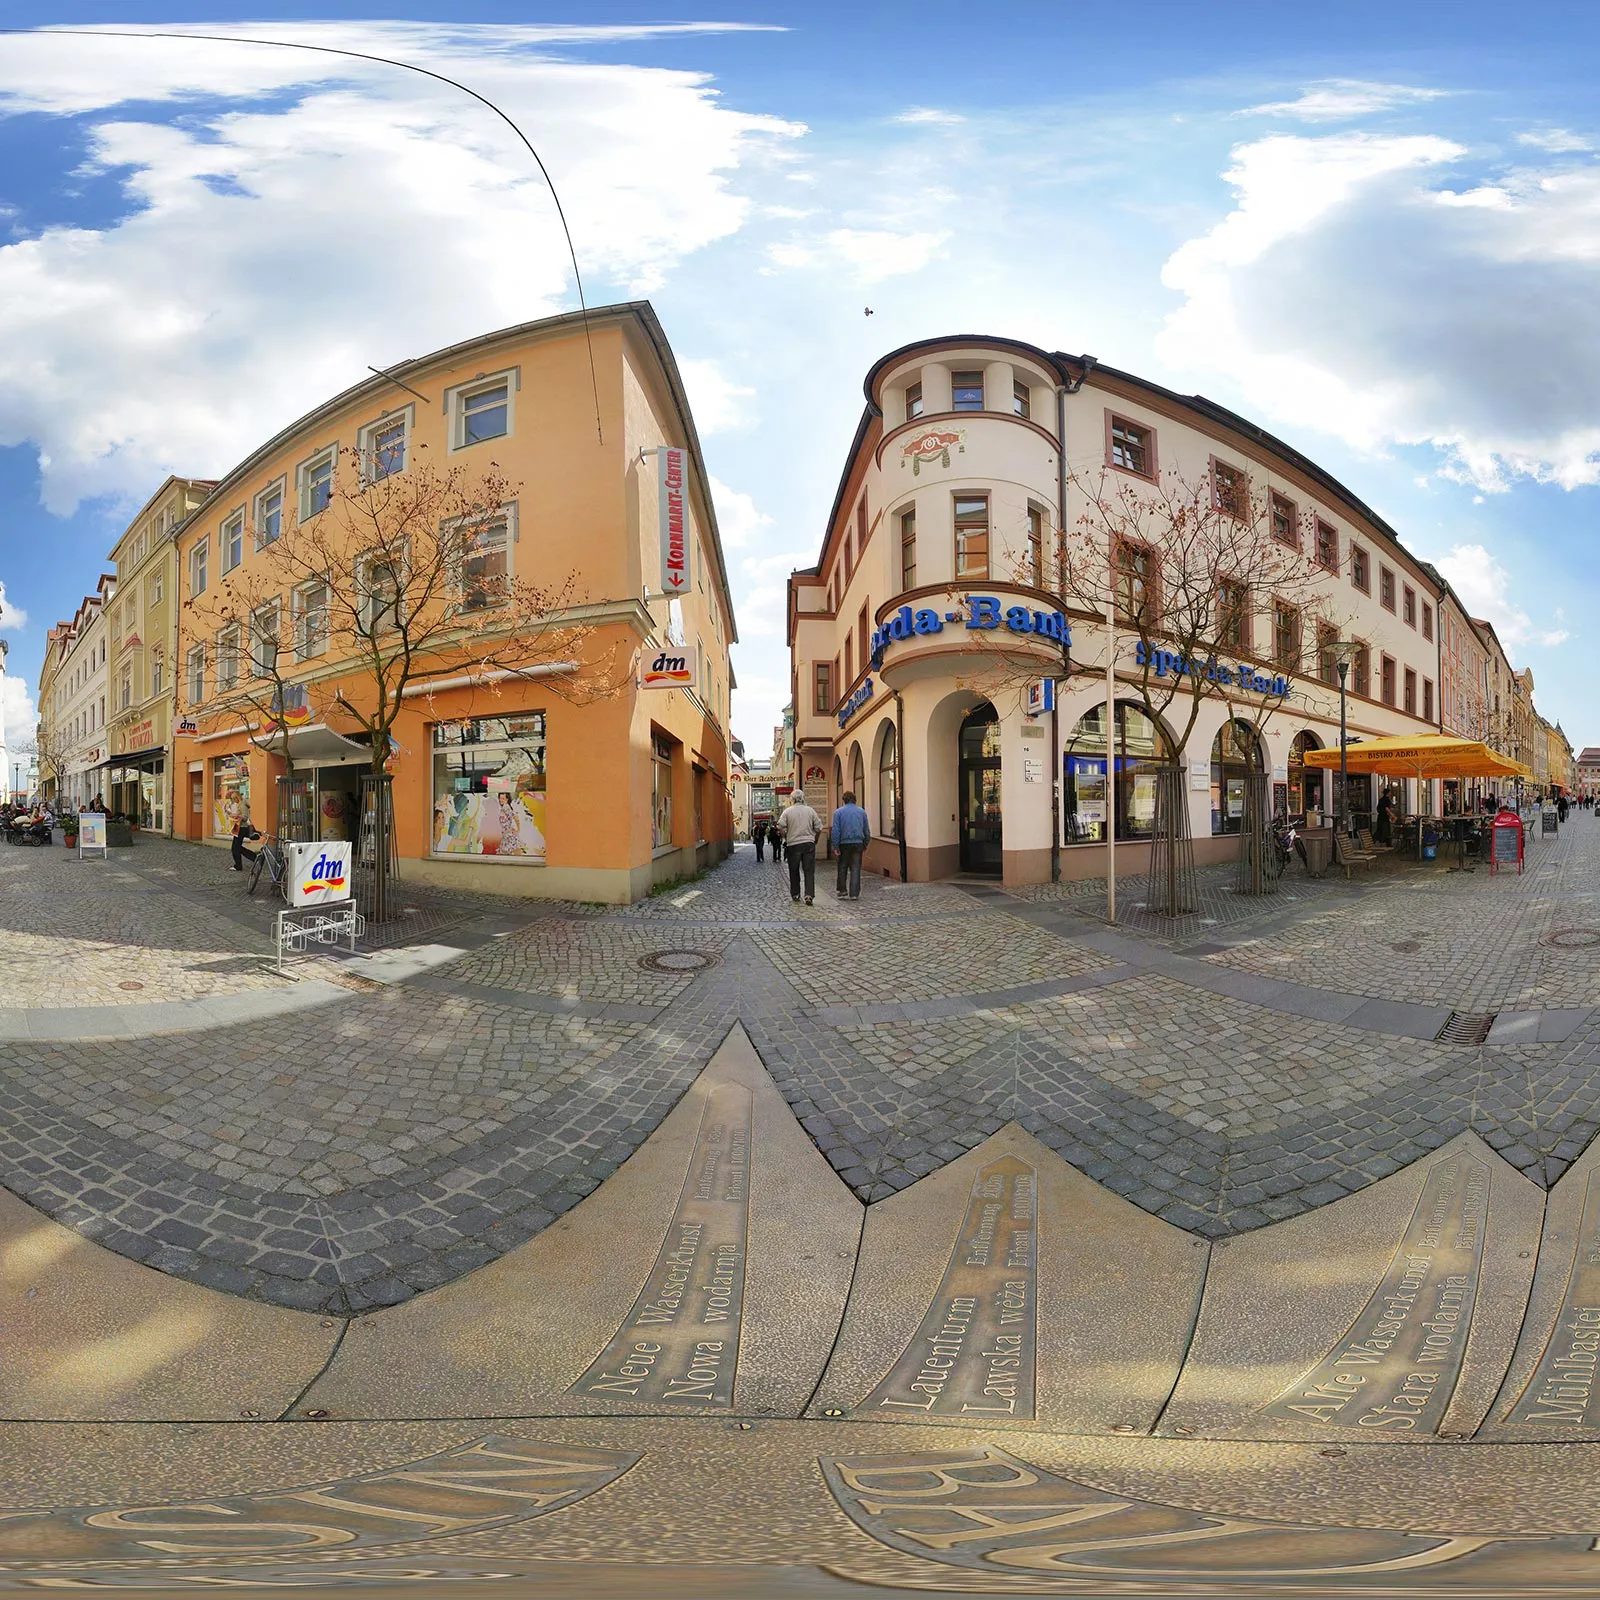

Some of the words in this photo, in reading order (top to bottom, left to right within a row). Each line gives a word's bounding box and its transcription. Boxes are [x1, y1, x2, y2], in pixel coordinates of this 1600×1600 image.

[180, 719, 197, 730] dm
[652, 652, 685, 672] dm
[1368, 752, 1394, 760] BISTRO
[1395, 750, 1419, 758] ADRIA
[311, 853, 344, 881] dm
[588, 1342, 663, 1397] Neue
[635, 1223, 703, 1326] Wasserkunst
[662, 1341, 725, 1401] Nowa
[703, 1243, 743, 1324] wodarnja
[880, 1296, 977, 1412] Lauenturm
[966, 1202, 1001, 1267] Entfernung
[960, 1334, 1024, 1415] Lawska
[1008, 1230, 1029, 1268] Erbaut
[1284, 1373, 1368, 1424] Alte
[1332, 1252, 1432, 1367] Wasserkunst
[1358, 1371, 1441, 1431] Stara
[1416, 1274, 1474, 1364] wodarnja
